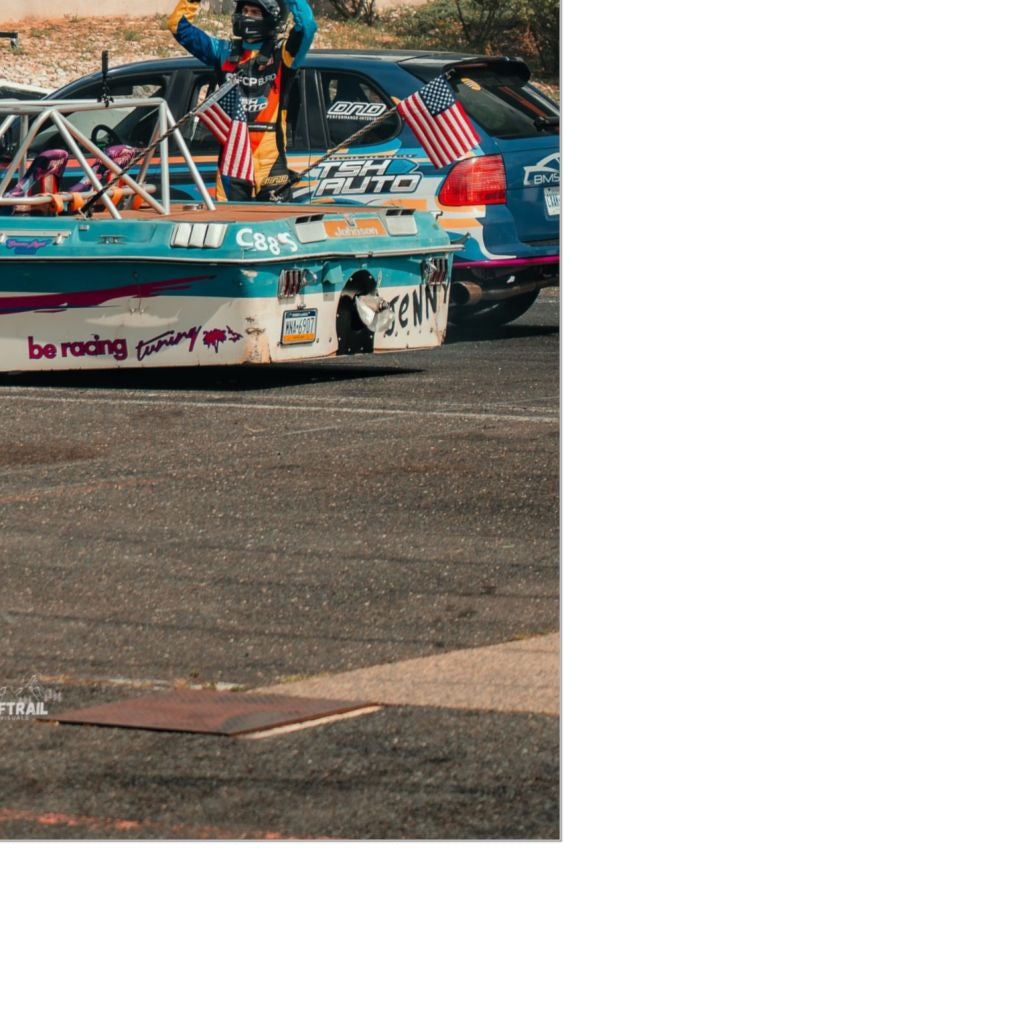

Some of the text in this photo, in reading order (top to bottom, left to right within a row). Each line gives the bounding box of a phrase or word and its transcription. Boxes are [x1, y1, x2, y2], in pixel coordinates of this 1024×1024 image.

[317, 159, 391, 178] TSH
[316, 175, 421, 195] AUTO
[28, 325, 202, 361] be racing tuning
